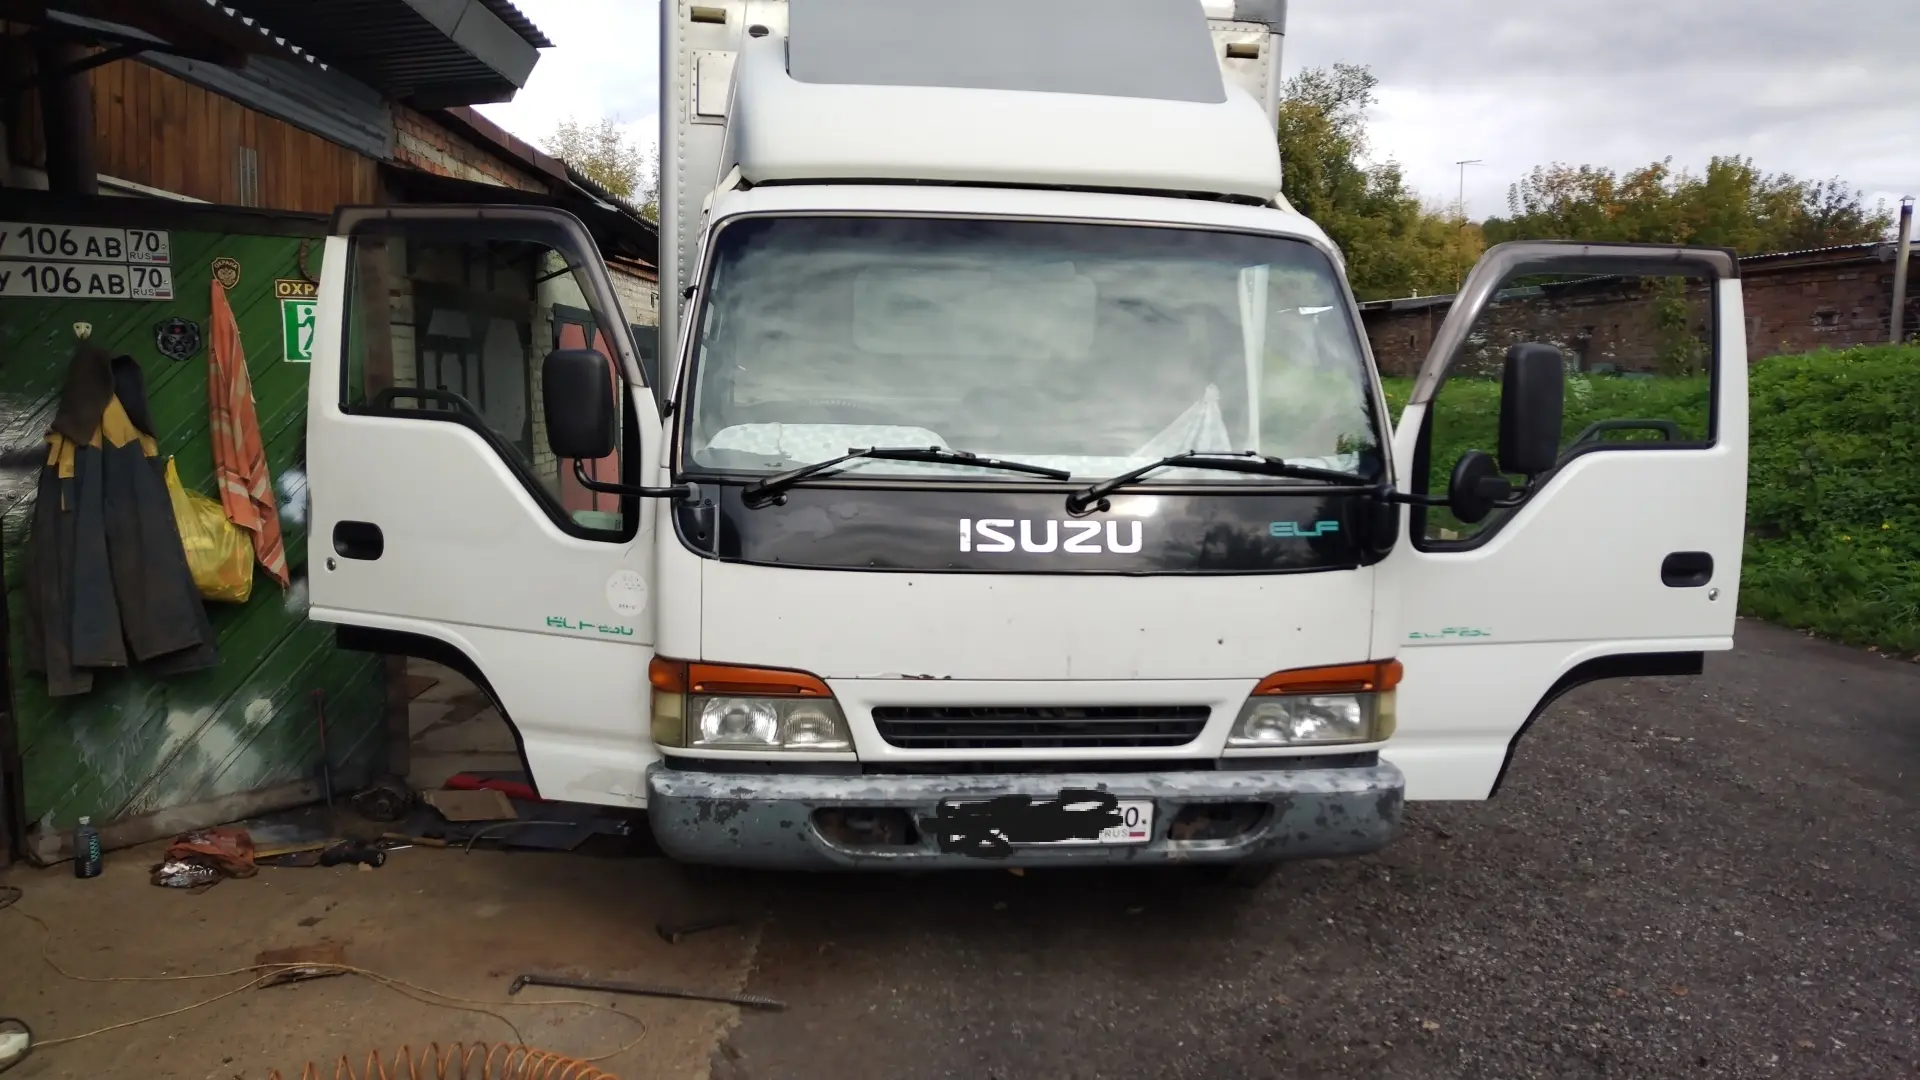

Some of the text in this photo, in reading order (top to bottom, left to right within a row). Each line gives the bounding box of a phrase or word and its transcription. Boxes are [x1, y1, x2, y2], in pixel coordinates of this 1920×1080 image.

[18, 226, 78, 256] 106
[130, 231, 160, 252] 70
[130, 252, 151, 260] RUS
[21, 265, 82, 294] 106
[133, 268, 163, 288] 70
[133, 288, 155, 297] RUS
[960, 518, 1143, 553] ISUZU
[1269, 520, 1340, 537] ELF
[1104, 828, 1128, 838] RUS
